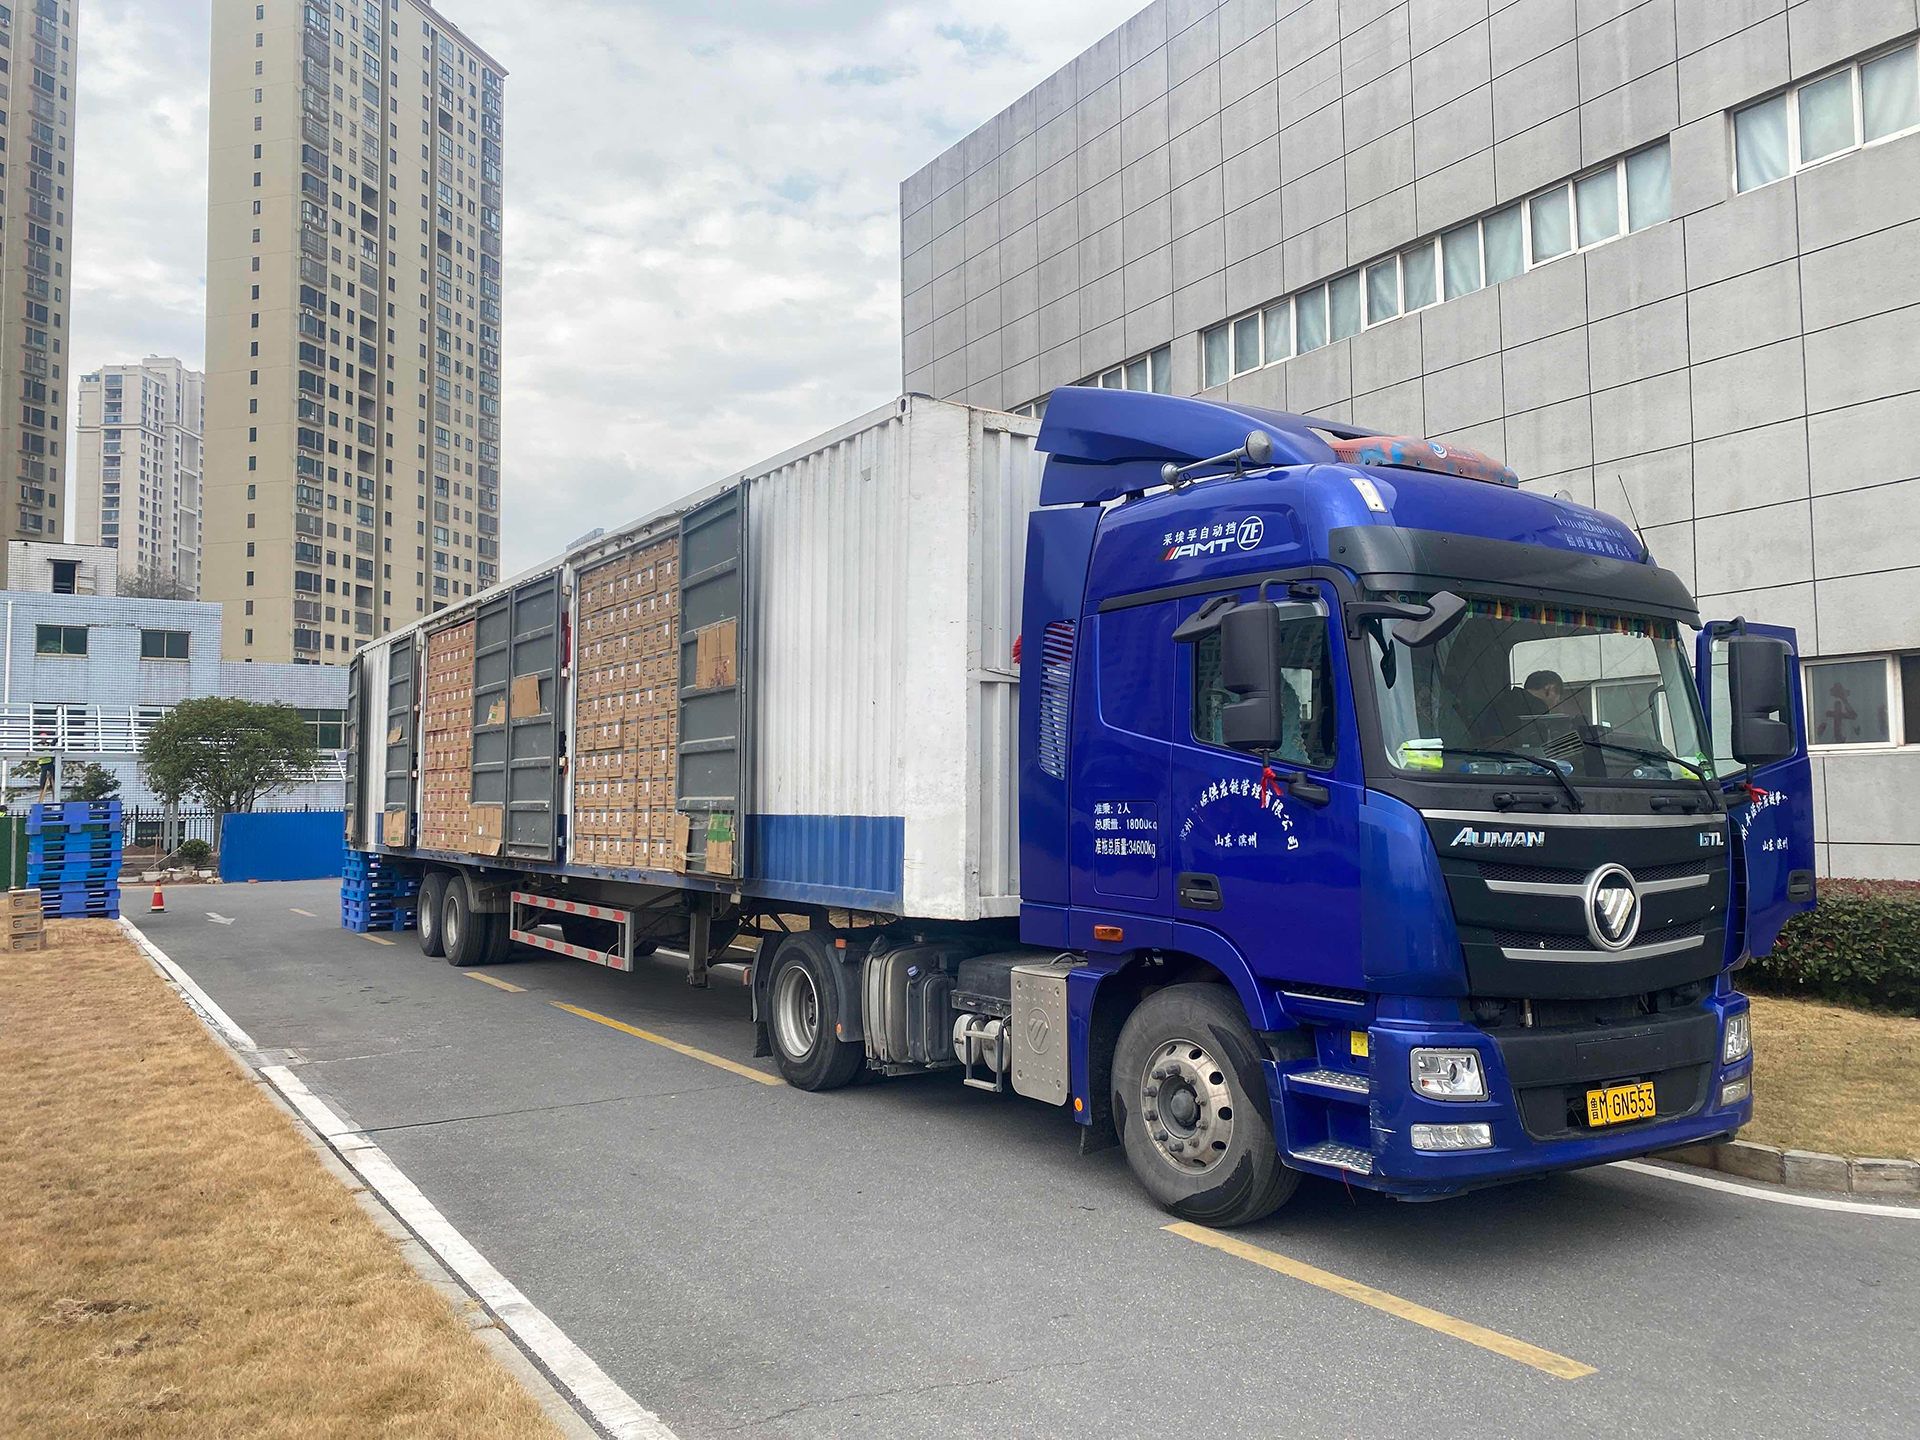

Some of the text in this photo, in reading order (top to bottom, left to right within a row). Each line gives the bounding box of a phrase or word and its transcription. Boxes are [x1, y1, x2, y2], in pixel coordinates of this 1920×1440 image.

[1163, 521, 1237, 546] 采埃孚自动挡
[1239, 520, 1262, 546] ZF
[1173, 537, 1235, 560] AMT
[1450, 827, 1545, 848] AUMAN
[1699, 832, 1725, 847] GTL
